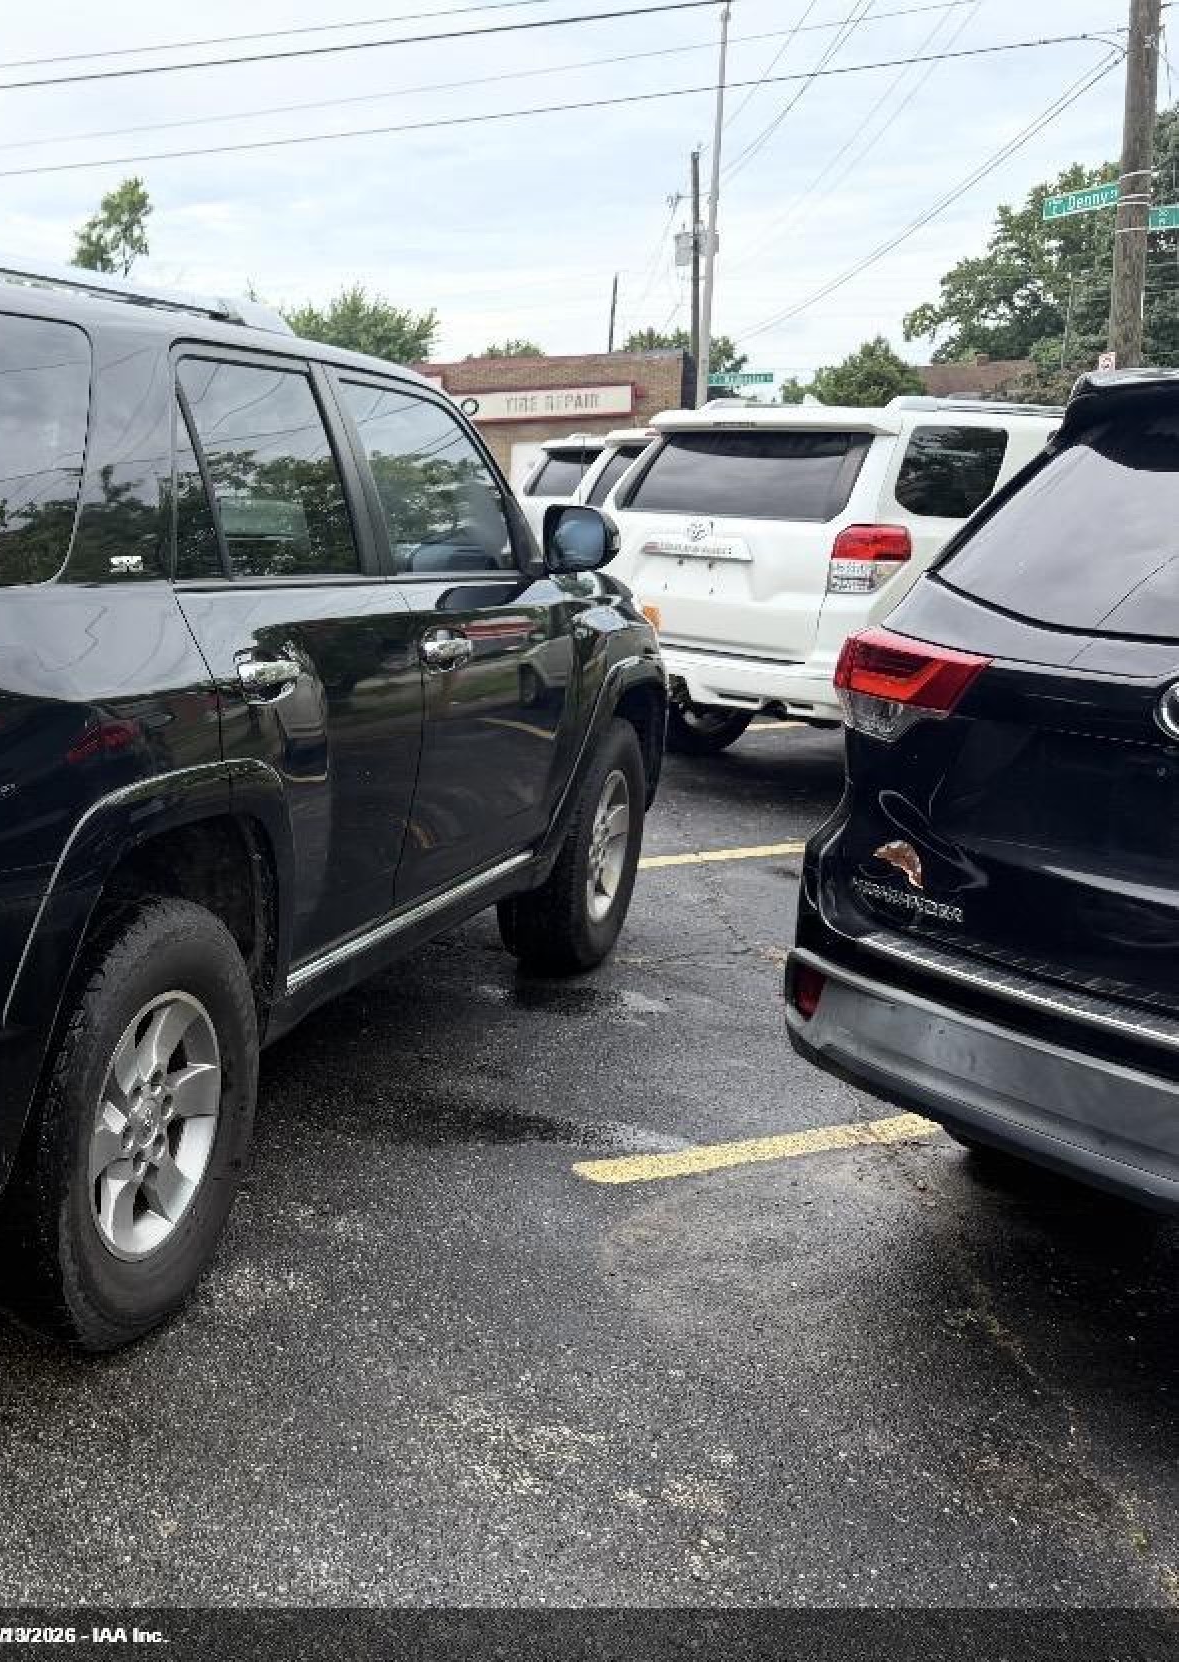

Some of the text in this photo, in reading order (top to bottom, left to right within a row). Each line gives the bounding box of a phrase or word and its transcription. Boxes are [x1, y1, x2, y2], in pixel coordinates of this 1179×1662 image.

[1068, 192, 1109, 211] Denny
[505, 393, 600, 413] TIRE REPAIR
